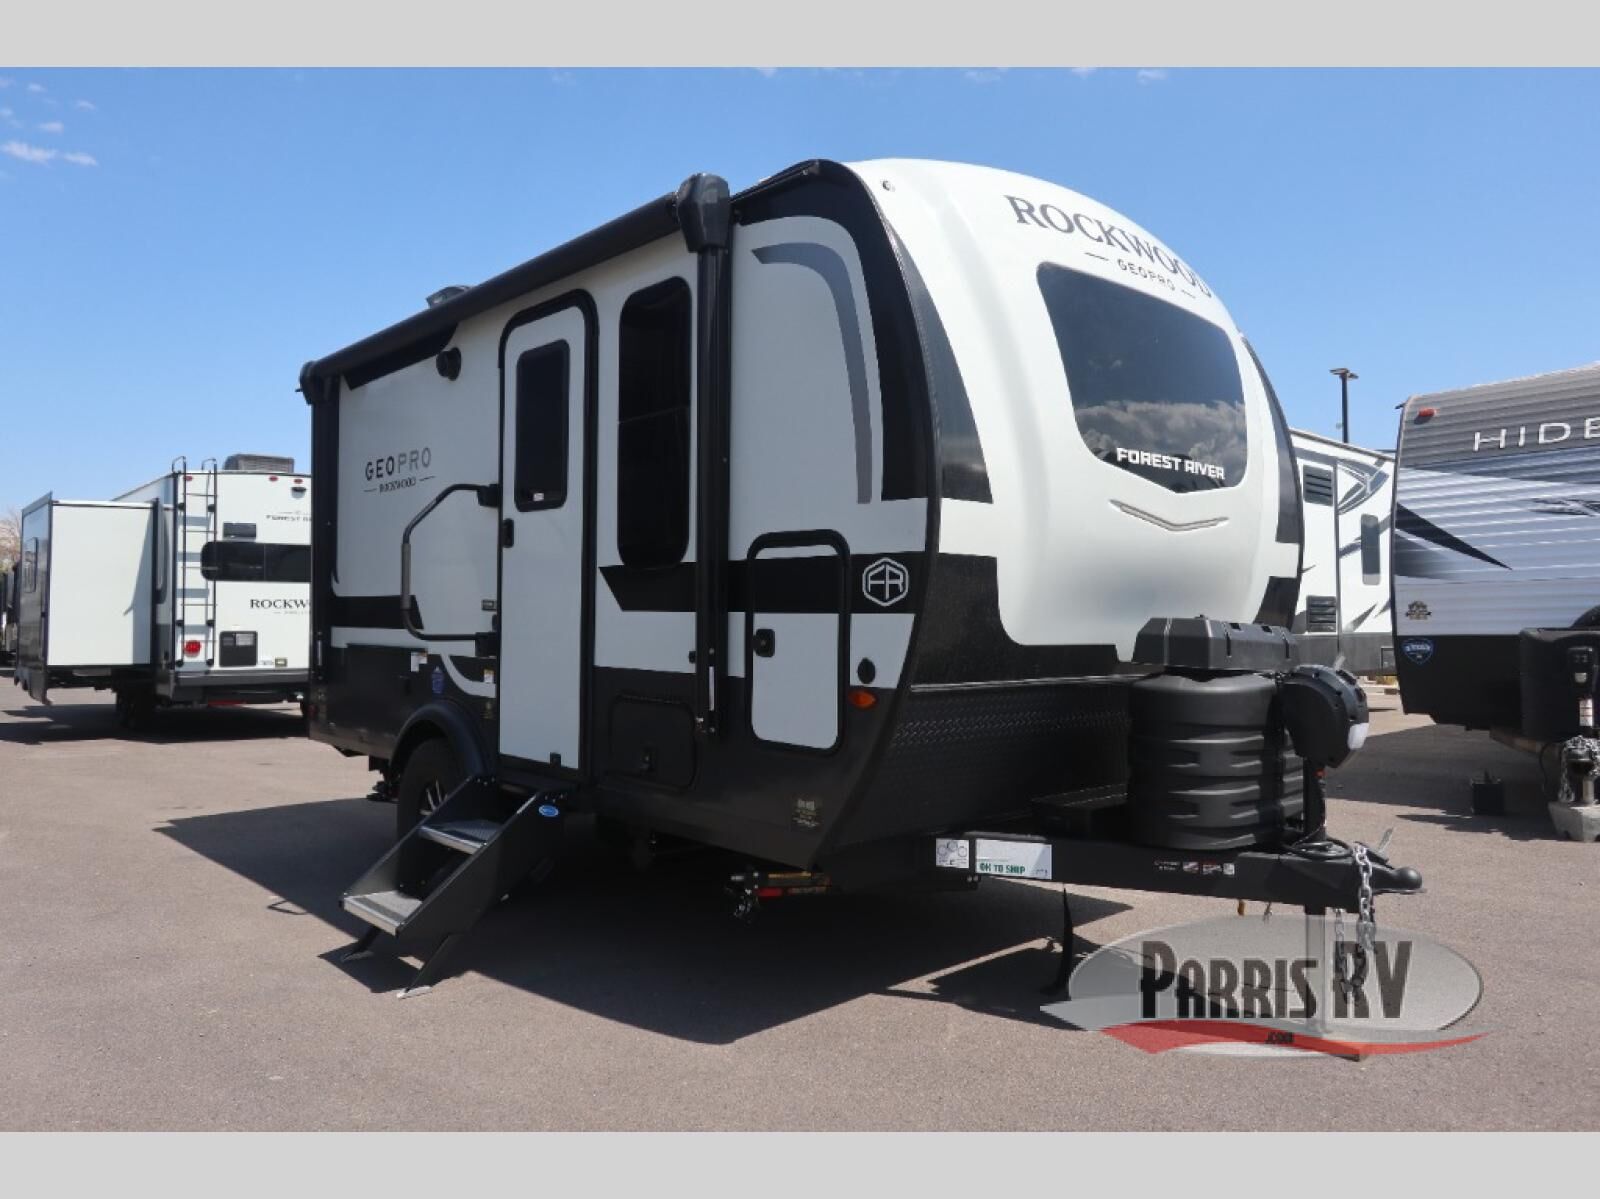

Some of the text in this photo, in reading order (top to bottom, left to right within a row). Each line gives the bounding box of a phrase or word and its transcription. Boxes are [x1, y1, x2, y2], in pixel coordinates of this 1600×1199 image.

[1117, 258, 1176, 291] GEOPRO
[365, 447, 432, 481] GEOPRO
[1116, 447, 1225, 480] FOREST RIVER
[250, 599, 309, 609] ROCKW
